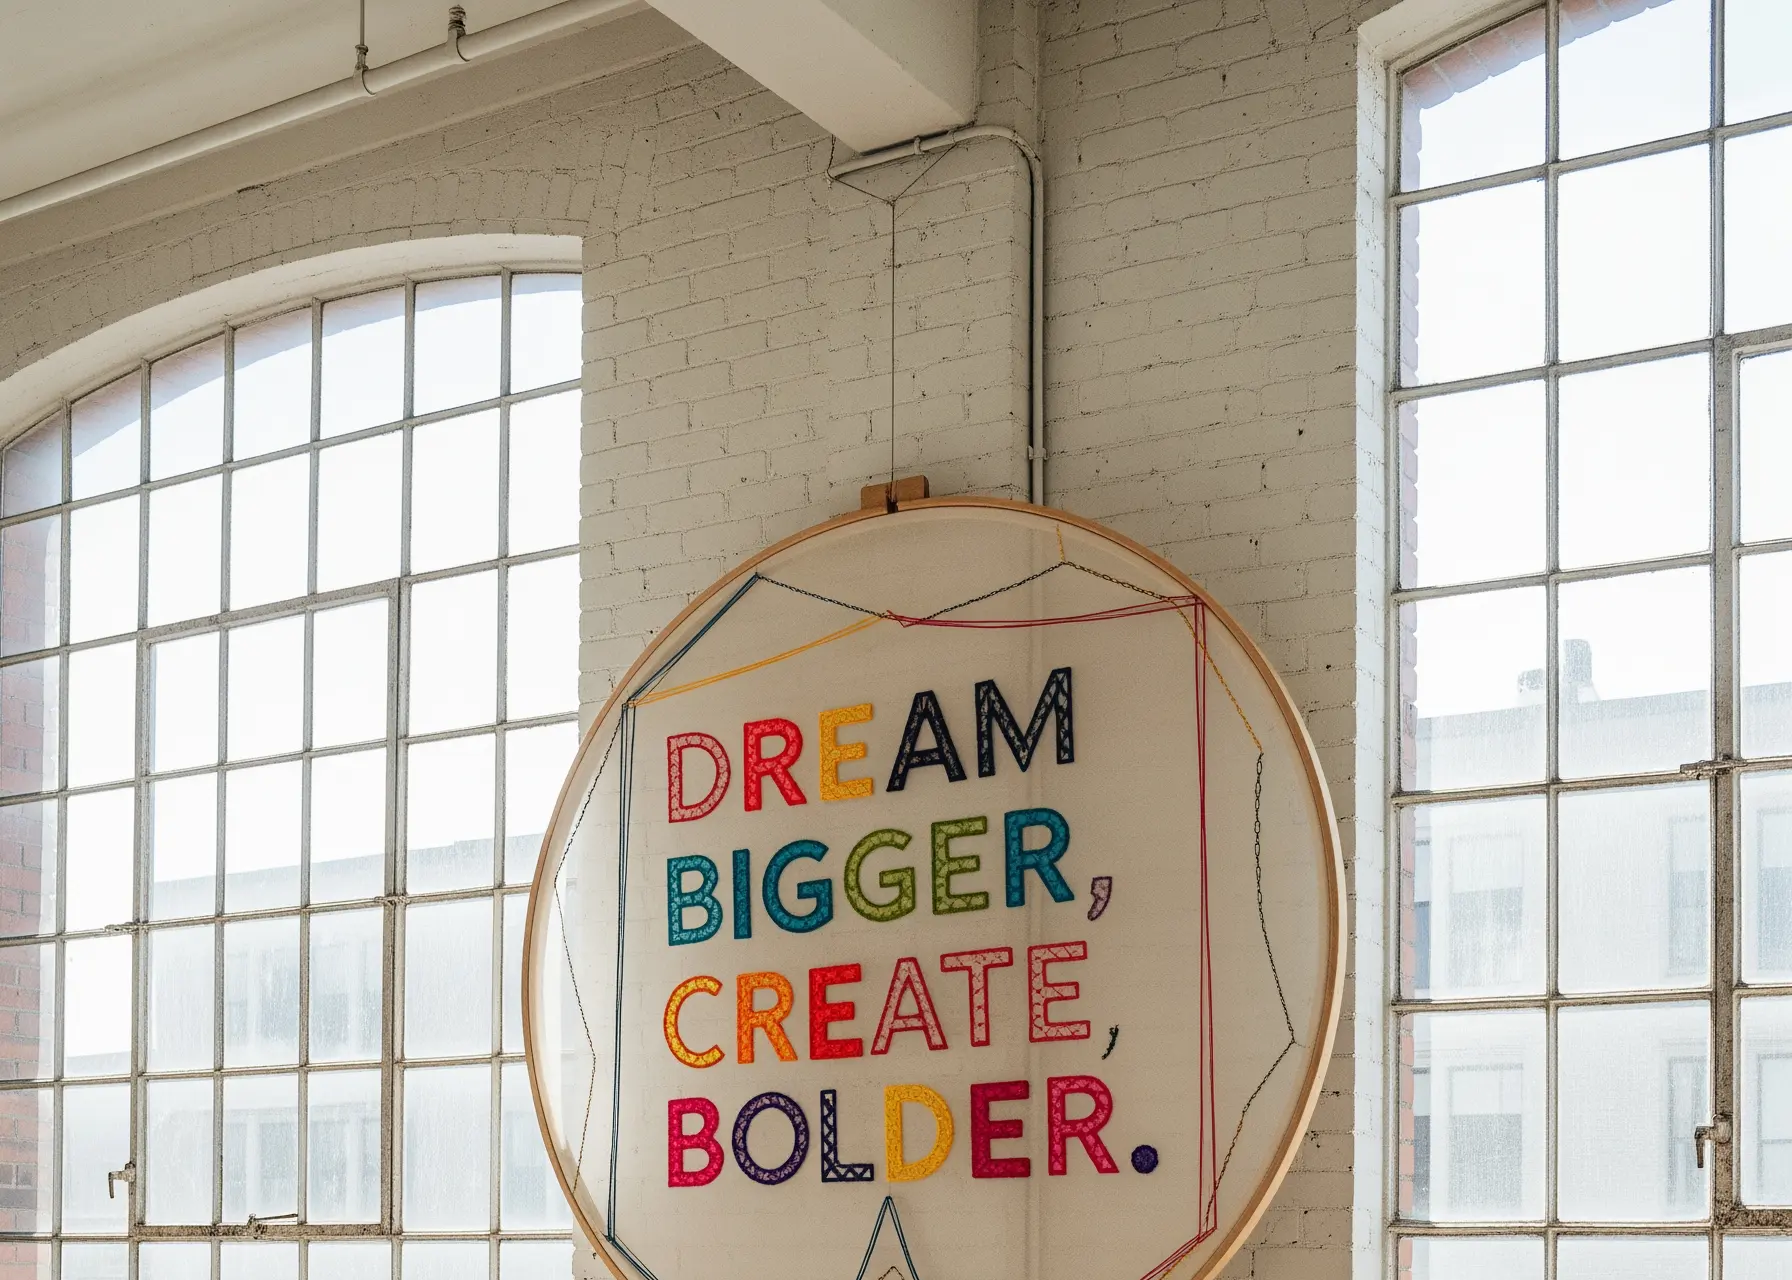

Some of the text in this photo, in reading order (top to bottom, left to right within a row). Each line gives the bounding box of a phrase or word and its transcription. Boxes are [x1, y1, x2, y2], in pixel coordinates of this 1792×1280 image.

[666, 666, 1075, 823] DREAM
[666, 807, 1113, 946] BIGGER,
[663, 941, 1121, 1068] CREATE,
[667, 1074, 1159, 1187] BOLDER.
